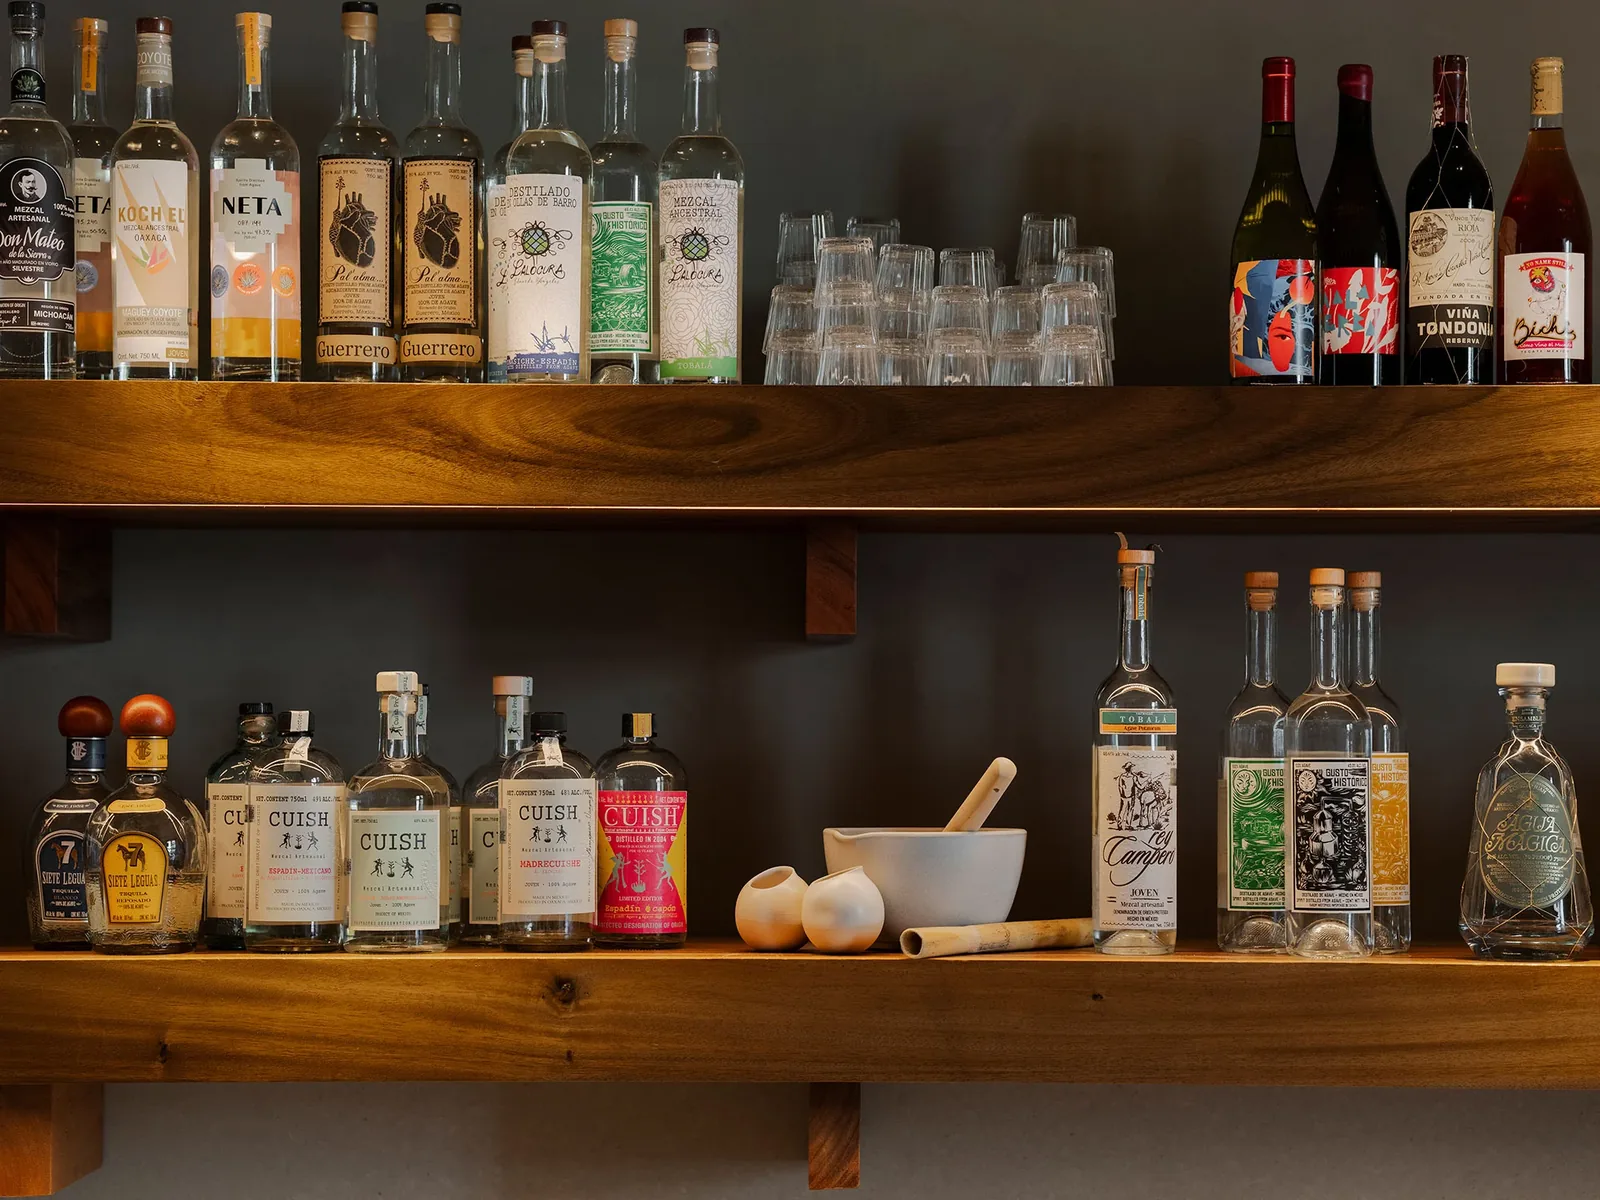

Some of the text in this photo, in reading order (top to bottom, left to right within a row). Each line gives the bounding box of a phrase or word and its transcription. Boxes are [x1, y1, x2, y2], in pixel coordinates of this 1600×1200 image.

[137, 52, 172, 65] COYOTE
[509, 186, 571, 198] DESTILADO
[75, 195, 111, 214] ETA
[222, 196, 282, 216] NETA
[537, 197, 548, 206] DE
[553, 198, 577, 208] BARRO
[673, 196, 717, 207] MEZCAL
[14, 206, 44, 214] MEZCAL
[118, 206, 185, 223] KOCH EL
[602, 211, 624, 220] GUSTO
[669, 208, 723, 218] ANCESTRAL
[8, 215, 51, 223] ARTESANAL
[1458, 224, 1480, 233] RIOJA
[23, 226, 65, 251] Mateo
[134, 234, 167, 242] OAXACA
[33, 310, 74, 321] MICHOACÁN
[122, 307, 182, 317] MAGUEY COYOTE
[1446, 306, 1480, 319] VIÑA
[1446, 337, 1480, 345] RESERVA
[168, 349, 189, 357] JOVEN
[317, 340, 390, 359] Guerrero
[402, 340, 475, 358] Guerrero
[676, 360, 713, 369] TOBALÁ
[1119, 714, 1167, 723] TOBALÁ
[1262, 768, 1284, 777] GUSTO
[1325, 768, 1349, 777] GUSTO
[1372, 763, 1393, 771] GUSTO
[519, 805, 578, 820] CUISH
[604, 806, 678, 826] CUISH
[269, 811, 329, 827] CUISH
[1496, 813, 1560, 833] AGUA
[360, 832, 427, 851] CUISH
[615, 835, 644, 843] DISTILLED
[61, 840, 76, 864] 7
[128, 842, 144, 867] 7
[520, 859, 581, 868] MADRECUISHE
[41, 871, 86, 885] SIETE LEGUA
[108, 874, 158, 888] SIETE LEGUAS
[1130, 888, 1159, 897] JOVEN
[605, 904, 641, 914] Espadín
